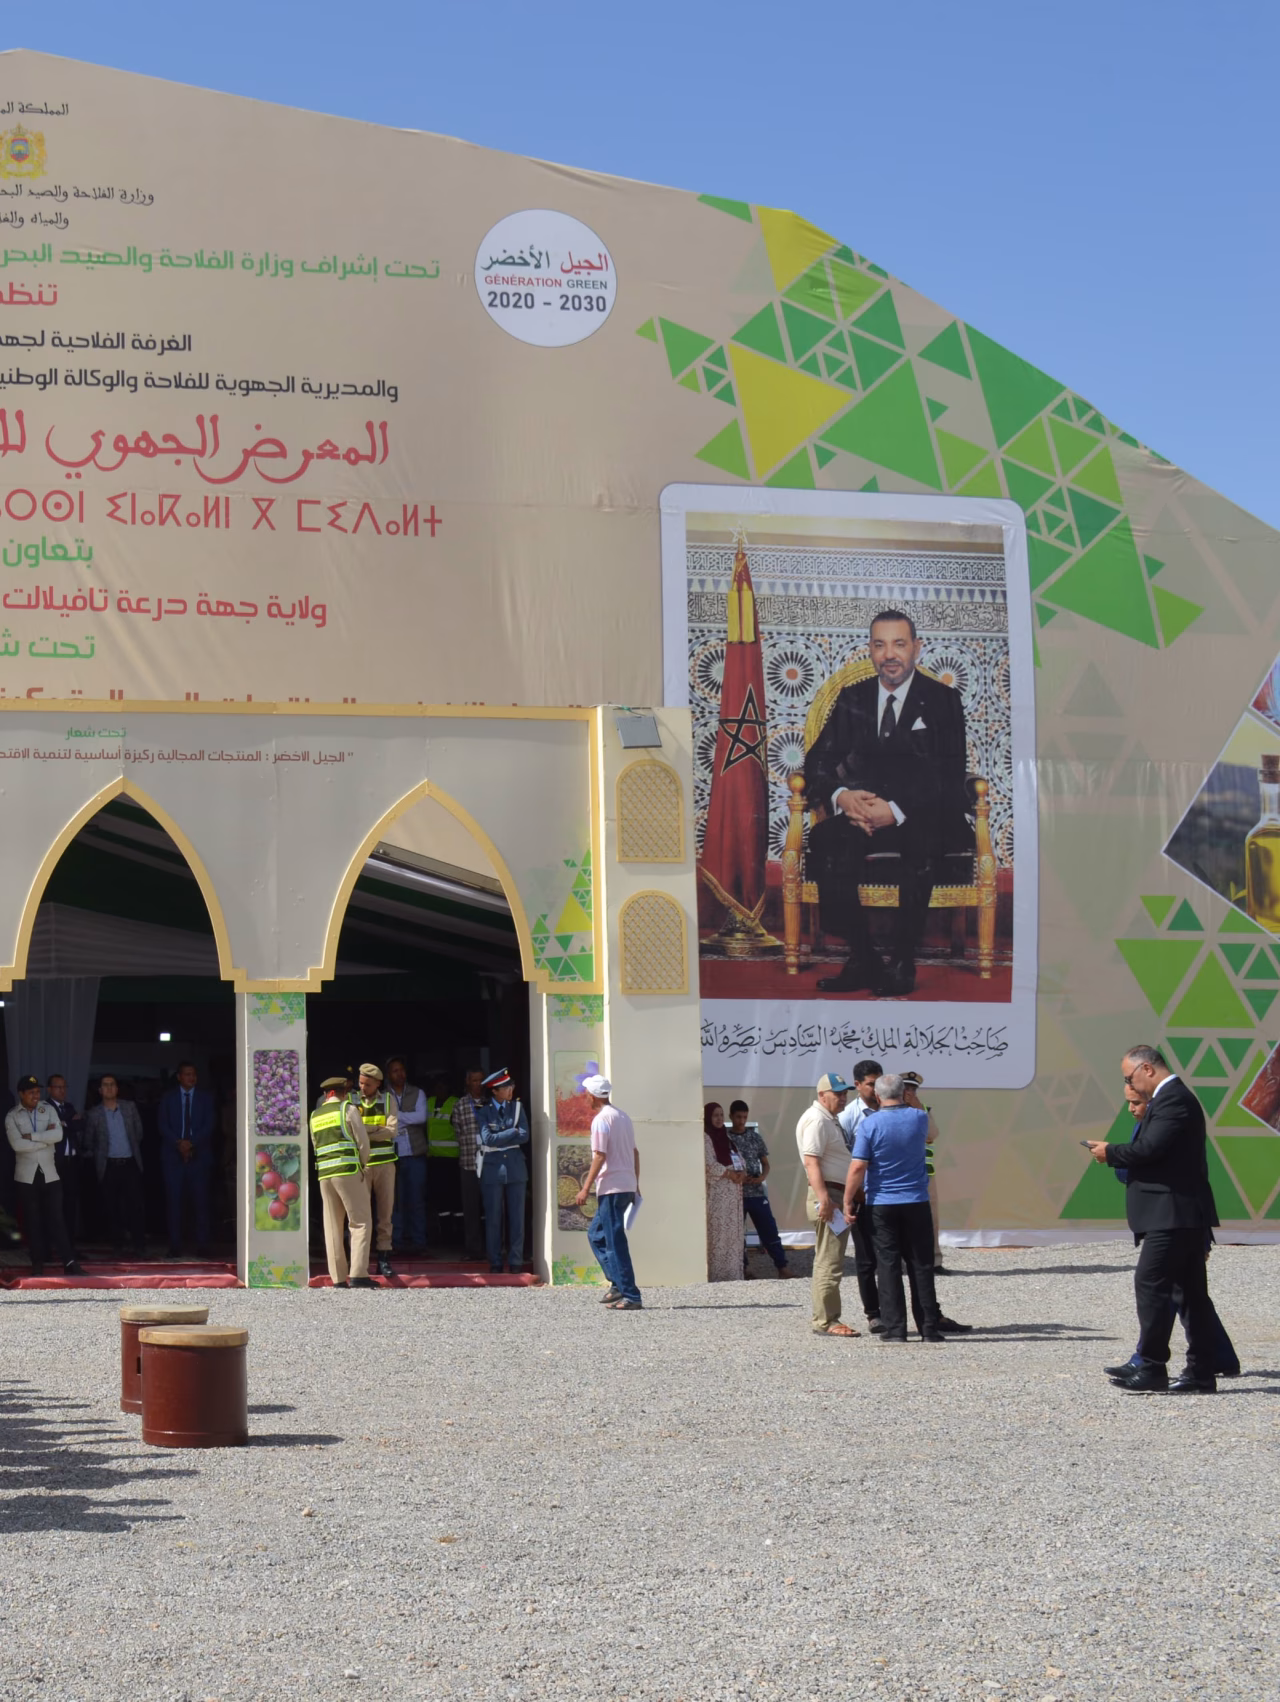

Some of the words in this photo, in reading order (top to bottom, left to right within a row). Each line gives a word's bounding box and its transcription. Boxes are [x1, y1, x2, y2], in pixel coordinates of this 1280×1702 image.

[18, 102, 69, 116] المملكة
[28, 186, 69, 202] والصيد
[73, 187, 114, 201] الفلاحة
[120, 188, 154, 205] وزارة
[31, 212, 69, 229] والمياه
[60, 246, 152, 272] والصيد
[160, 249, 234, 270] الفلاحة
[241, 251, 294, 278] وزارة
[301, 253, 378, 282] إشراف
[480, 244, 550, 271] الأخضر
[560, 251, 608, 276] الجيل
[384, 259, 440, 279] تحت
[485, 274, 562, 288] GÉNÉRATION
[567, 279, 608, 290] GREEN
[487, 291, 535, 309] 2020
[559, 294, 607, 312] 2030
[51, 331, 125, 353] الفلاحية
[131, 334, 192, 355] الغرفة
[64, 369, 138, 392] والوكالة
[144, 371, 209, 390] للفلاحة
[215, 374, 295, 396] الجهوية
[301, 377, 399, 403] والمديرية
[45, 414, 220, 479] الجهوي
[193, 420, 389, 484] المعرض
[2, 536, 94, 569] بتعاون
[3, 586, 109, 617] تافيلالت
[116, 588, 188, 621] درعة
[196, 592, 259, 623] جهة
[267, 594, 327, 629] ولاية
[28, 633, 95, 659] تحت
[65, 726, 95, 740] شعار
[98, 727, 127, 738] تحت
[33, 749, 71, 763] لتنمية
[124, 749, 155, 764] ركيزة
[157, 749, 205, 764] المجالية
[208, 750, 262, 763] المنتجات
[313, 751, 345, 765] الجيل
